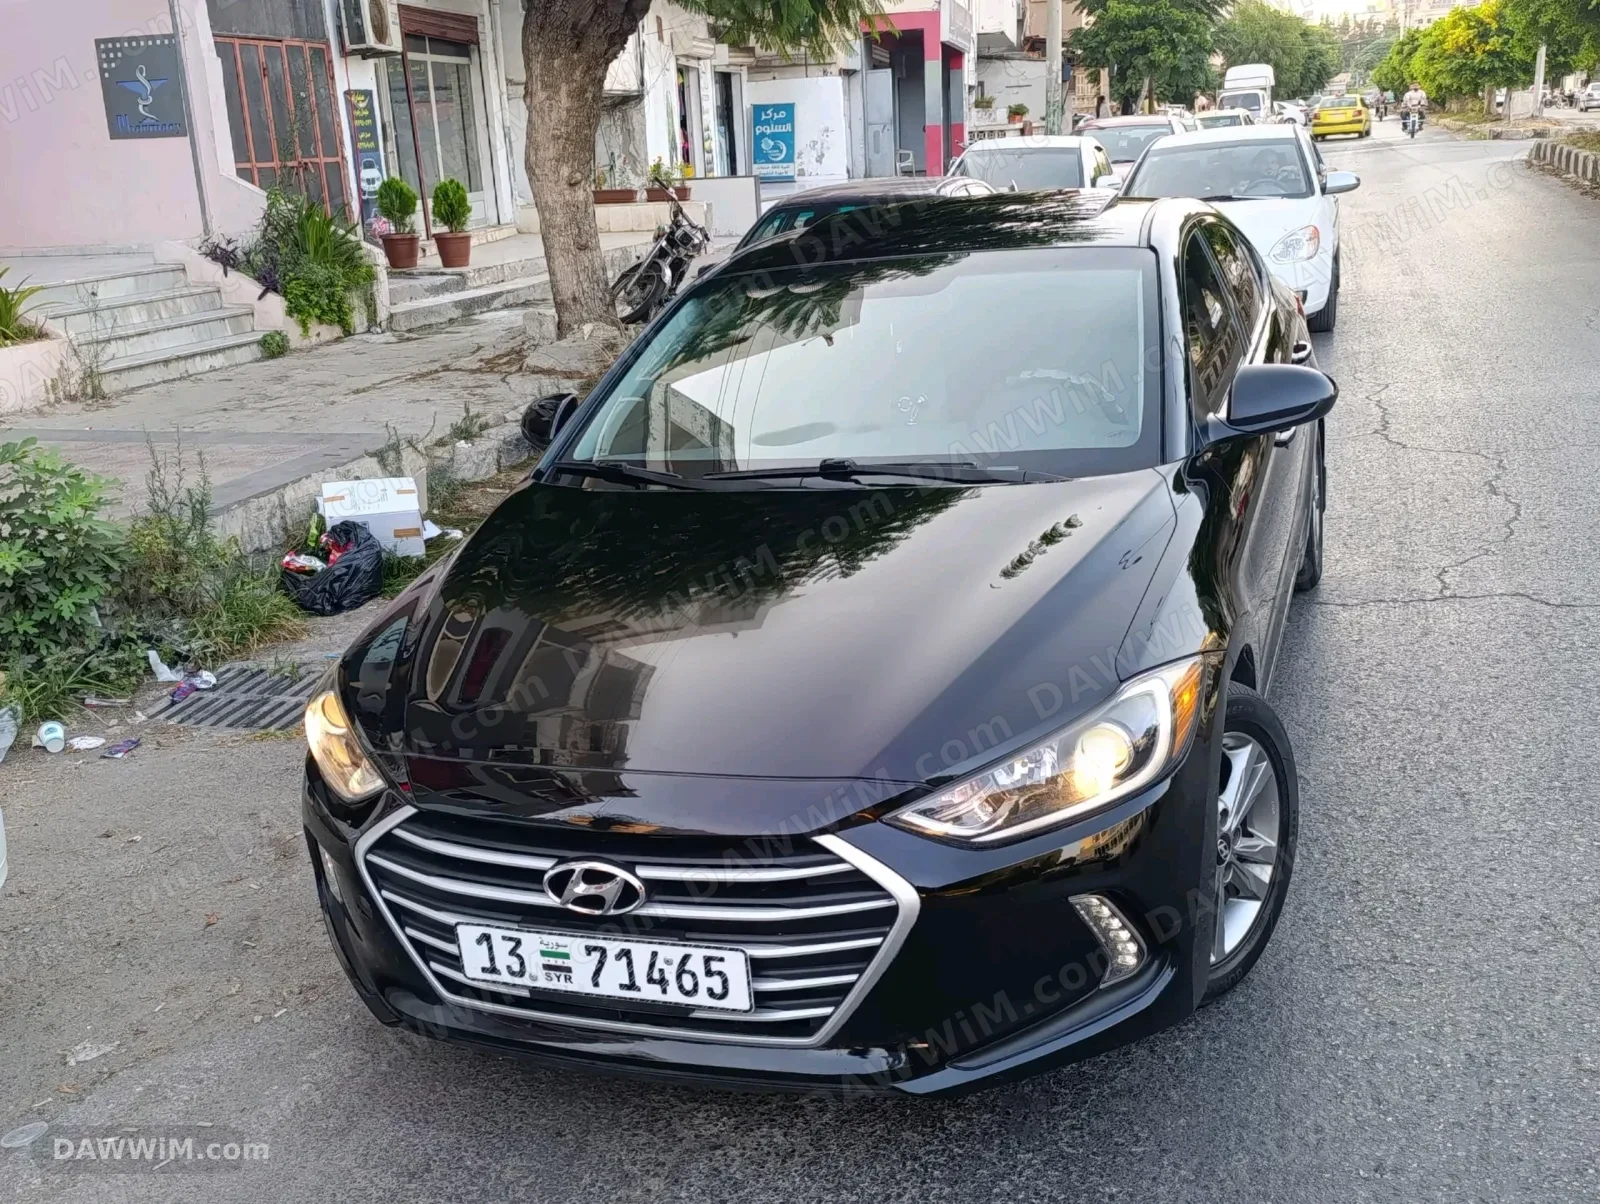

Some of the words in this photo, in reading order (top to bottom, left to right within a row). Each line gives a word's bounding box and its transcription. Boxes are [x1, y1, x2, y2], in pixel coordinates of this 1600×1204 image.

[755, 123, 792, 135] السلوم
[539, 937, 568, 949] سورية
[476, 932, 527, 979] 13
[585, 944, 729, 1001] 71465
[545, 972, 573, 984] SYR
